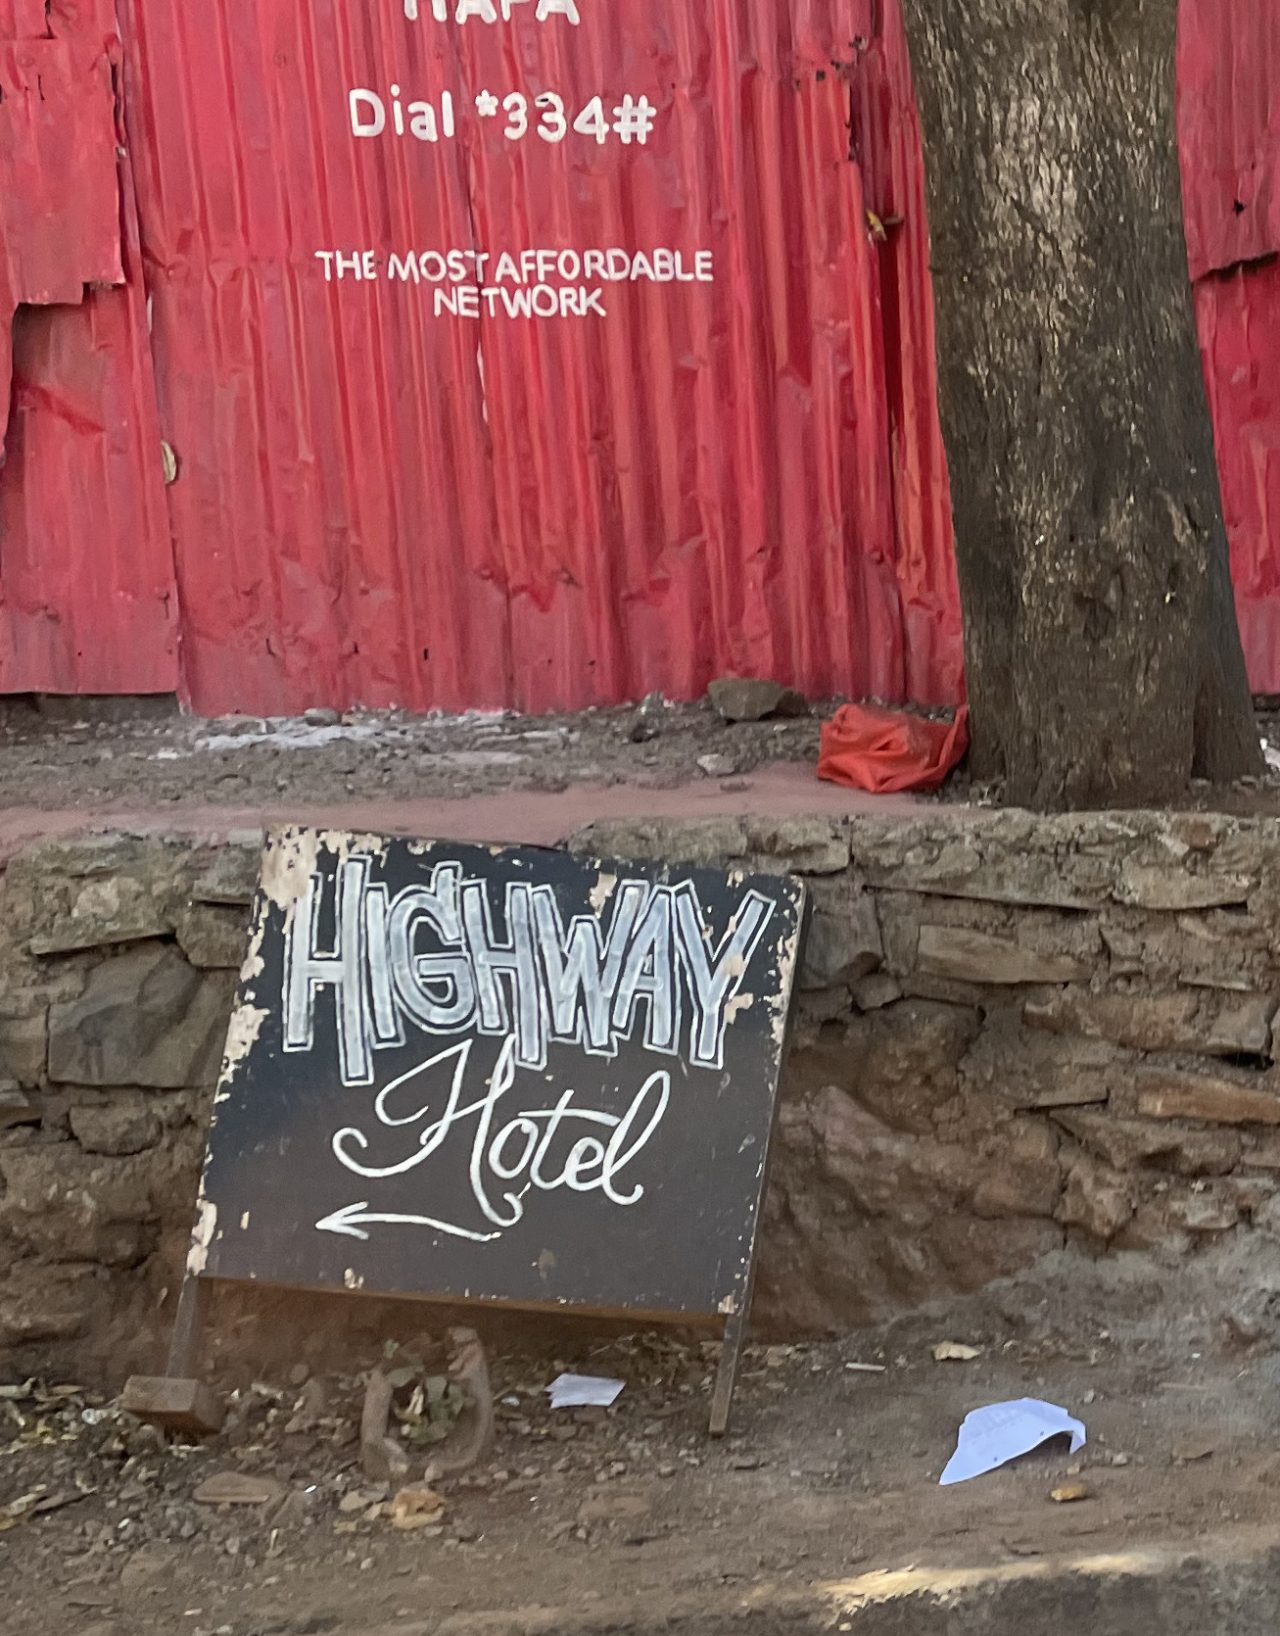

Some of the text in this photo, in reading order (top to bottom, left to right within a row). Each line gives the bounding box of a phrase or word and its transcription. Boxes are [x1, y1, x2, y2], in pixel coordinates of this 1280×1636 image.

[349, 83, 455, 142] Dial
[314, 248, 714, 284] THE MOST AFFORDABLE
[434, 284, 607, 319] NETWORK
[282, 854, 777, 1087] HIGHWAY
[332, 1032, 671, 1227] Hotel
